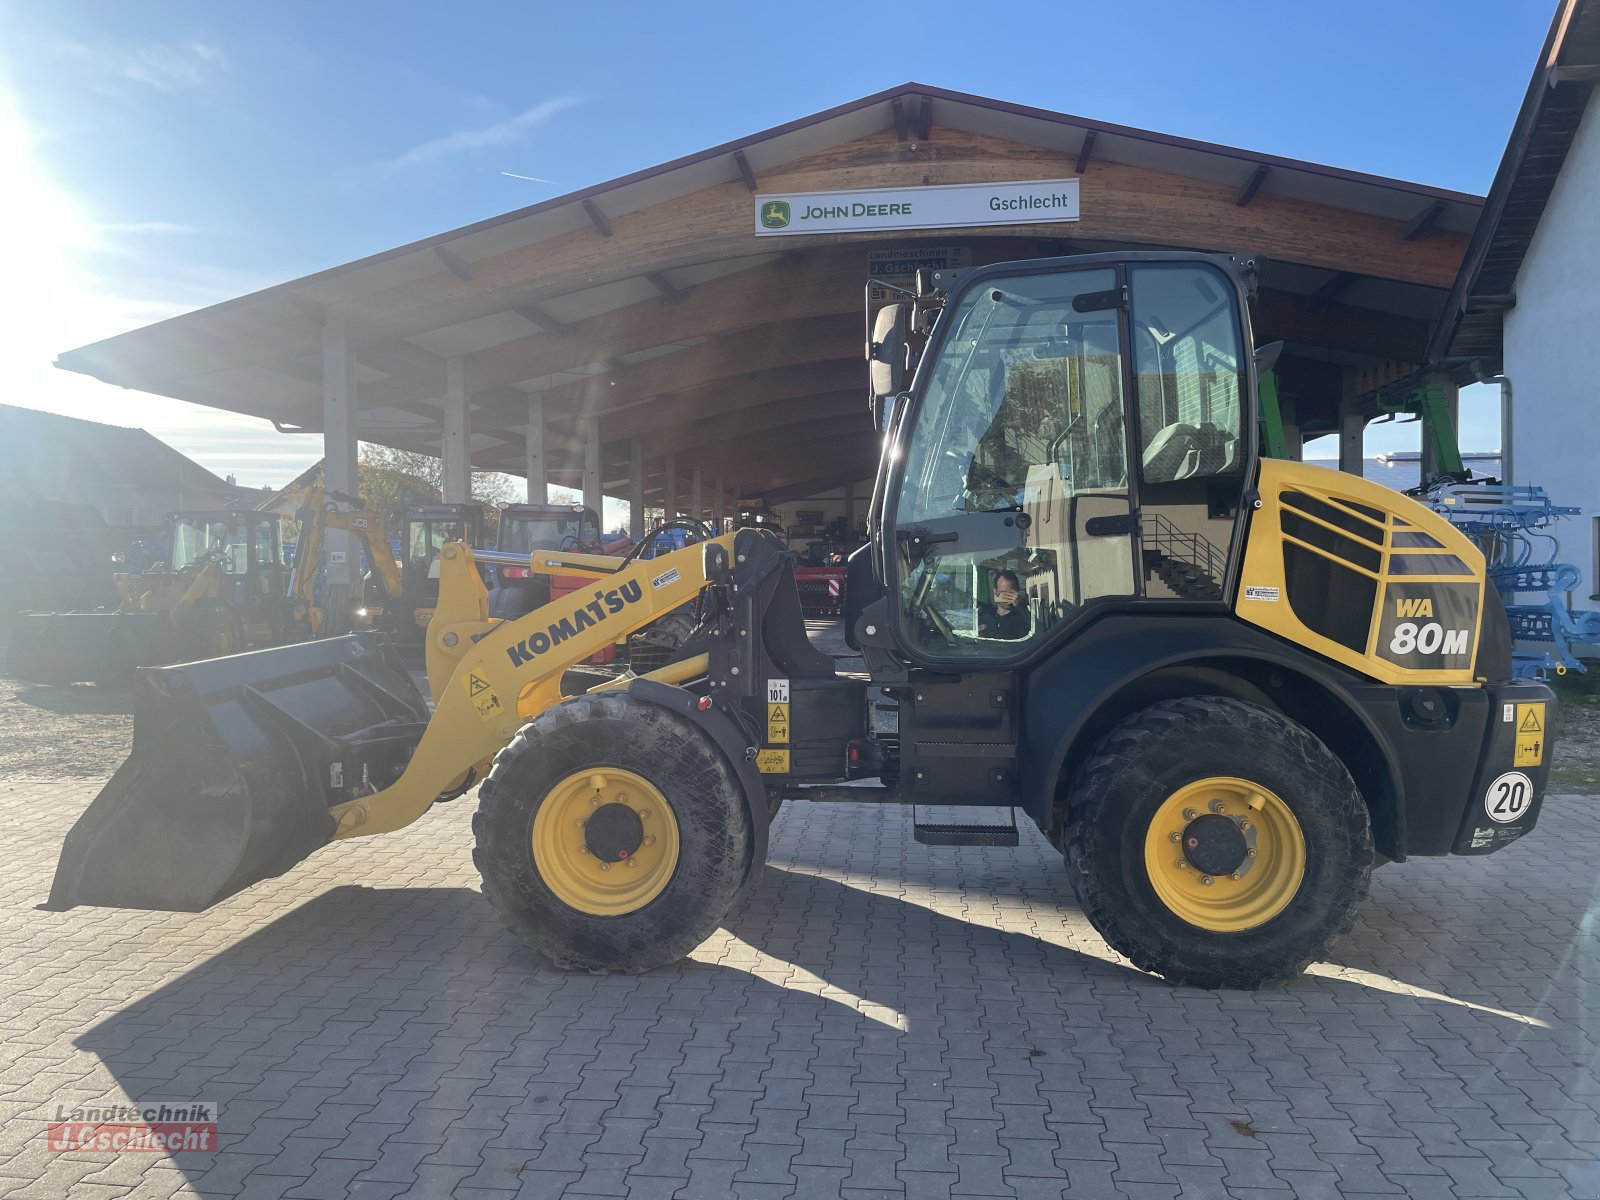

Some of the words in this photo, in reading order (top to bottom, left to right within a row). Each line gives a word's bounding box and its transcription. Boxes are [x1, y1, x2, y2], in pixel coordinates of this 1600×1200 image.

[801, 205, 849, 219] JOHN
[852, 203, 912, 217] DEERE
[989, 193, 1068, 211] Gschlecht
[870, 247, 948, 260] Landmaschinen
[352, 517, 369, 529] JCB
[1396, 598, 1434, 618] WA
[506, 578, 643, 668] KOMATSU
[1390, 622, 1469, 655] 80M
[770, 690, 782, 701] 101
[1493, 781, 1525, 814] 20
